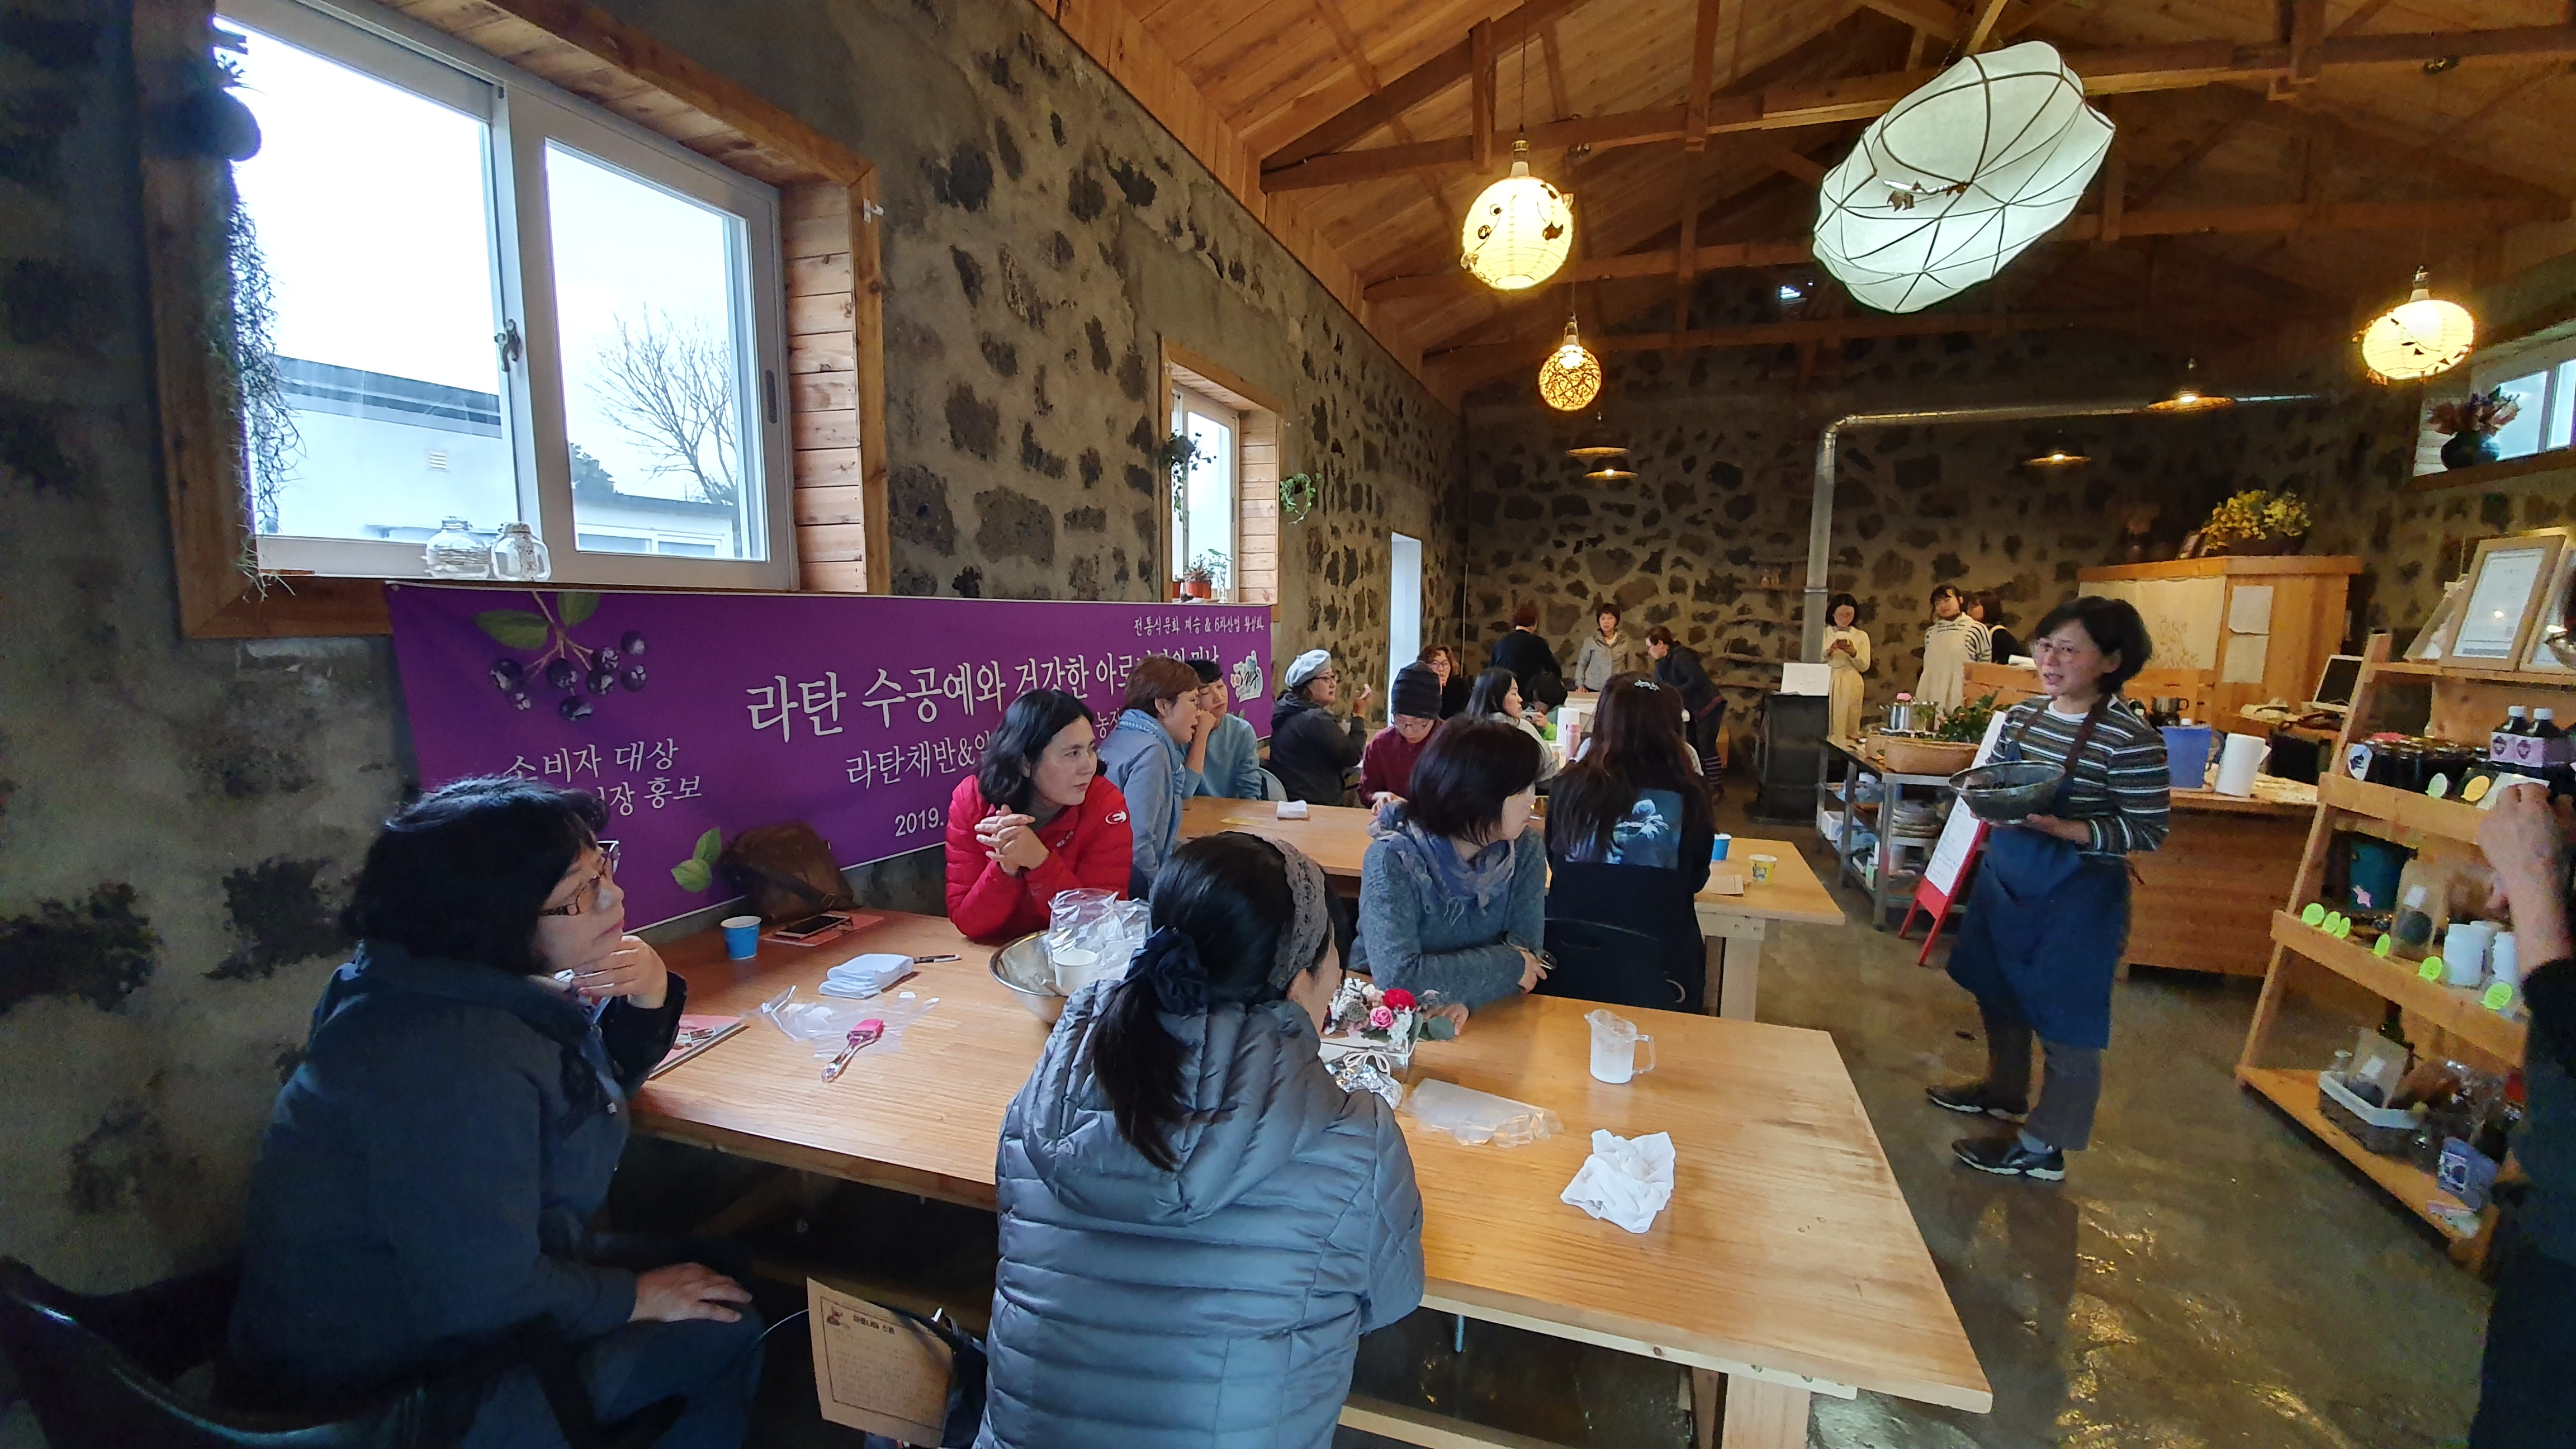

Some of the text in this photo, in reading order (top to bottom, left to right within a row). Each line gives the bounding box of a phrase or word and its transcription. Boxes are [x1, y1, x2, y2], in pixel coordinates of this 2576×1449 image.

[1134, 615, 1180, 636] 전통식문화
[1205, 617, 1211, 632] &
[1214, 615, 1240, 633] 6차산업
[746, 671, 846, 742] 라탄
[862, 660, 1006, 728] 수공예와
[504, 738, 679, 783] 소비자 대상
[644, 775, 703, 809] 홍보
